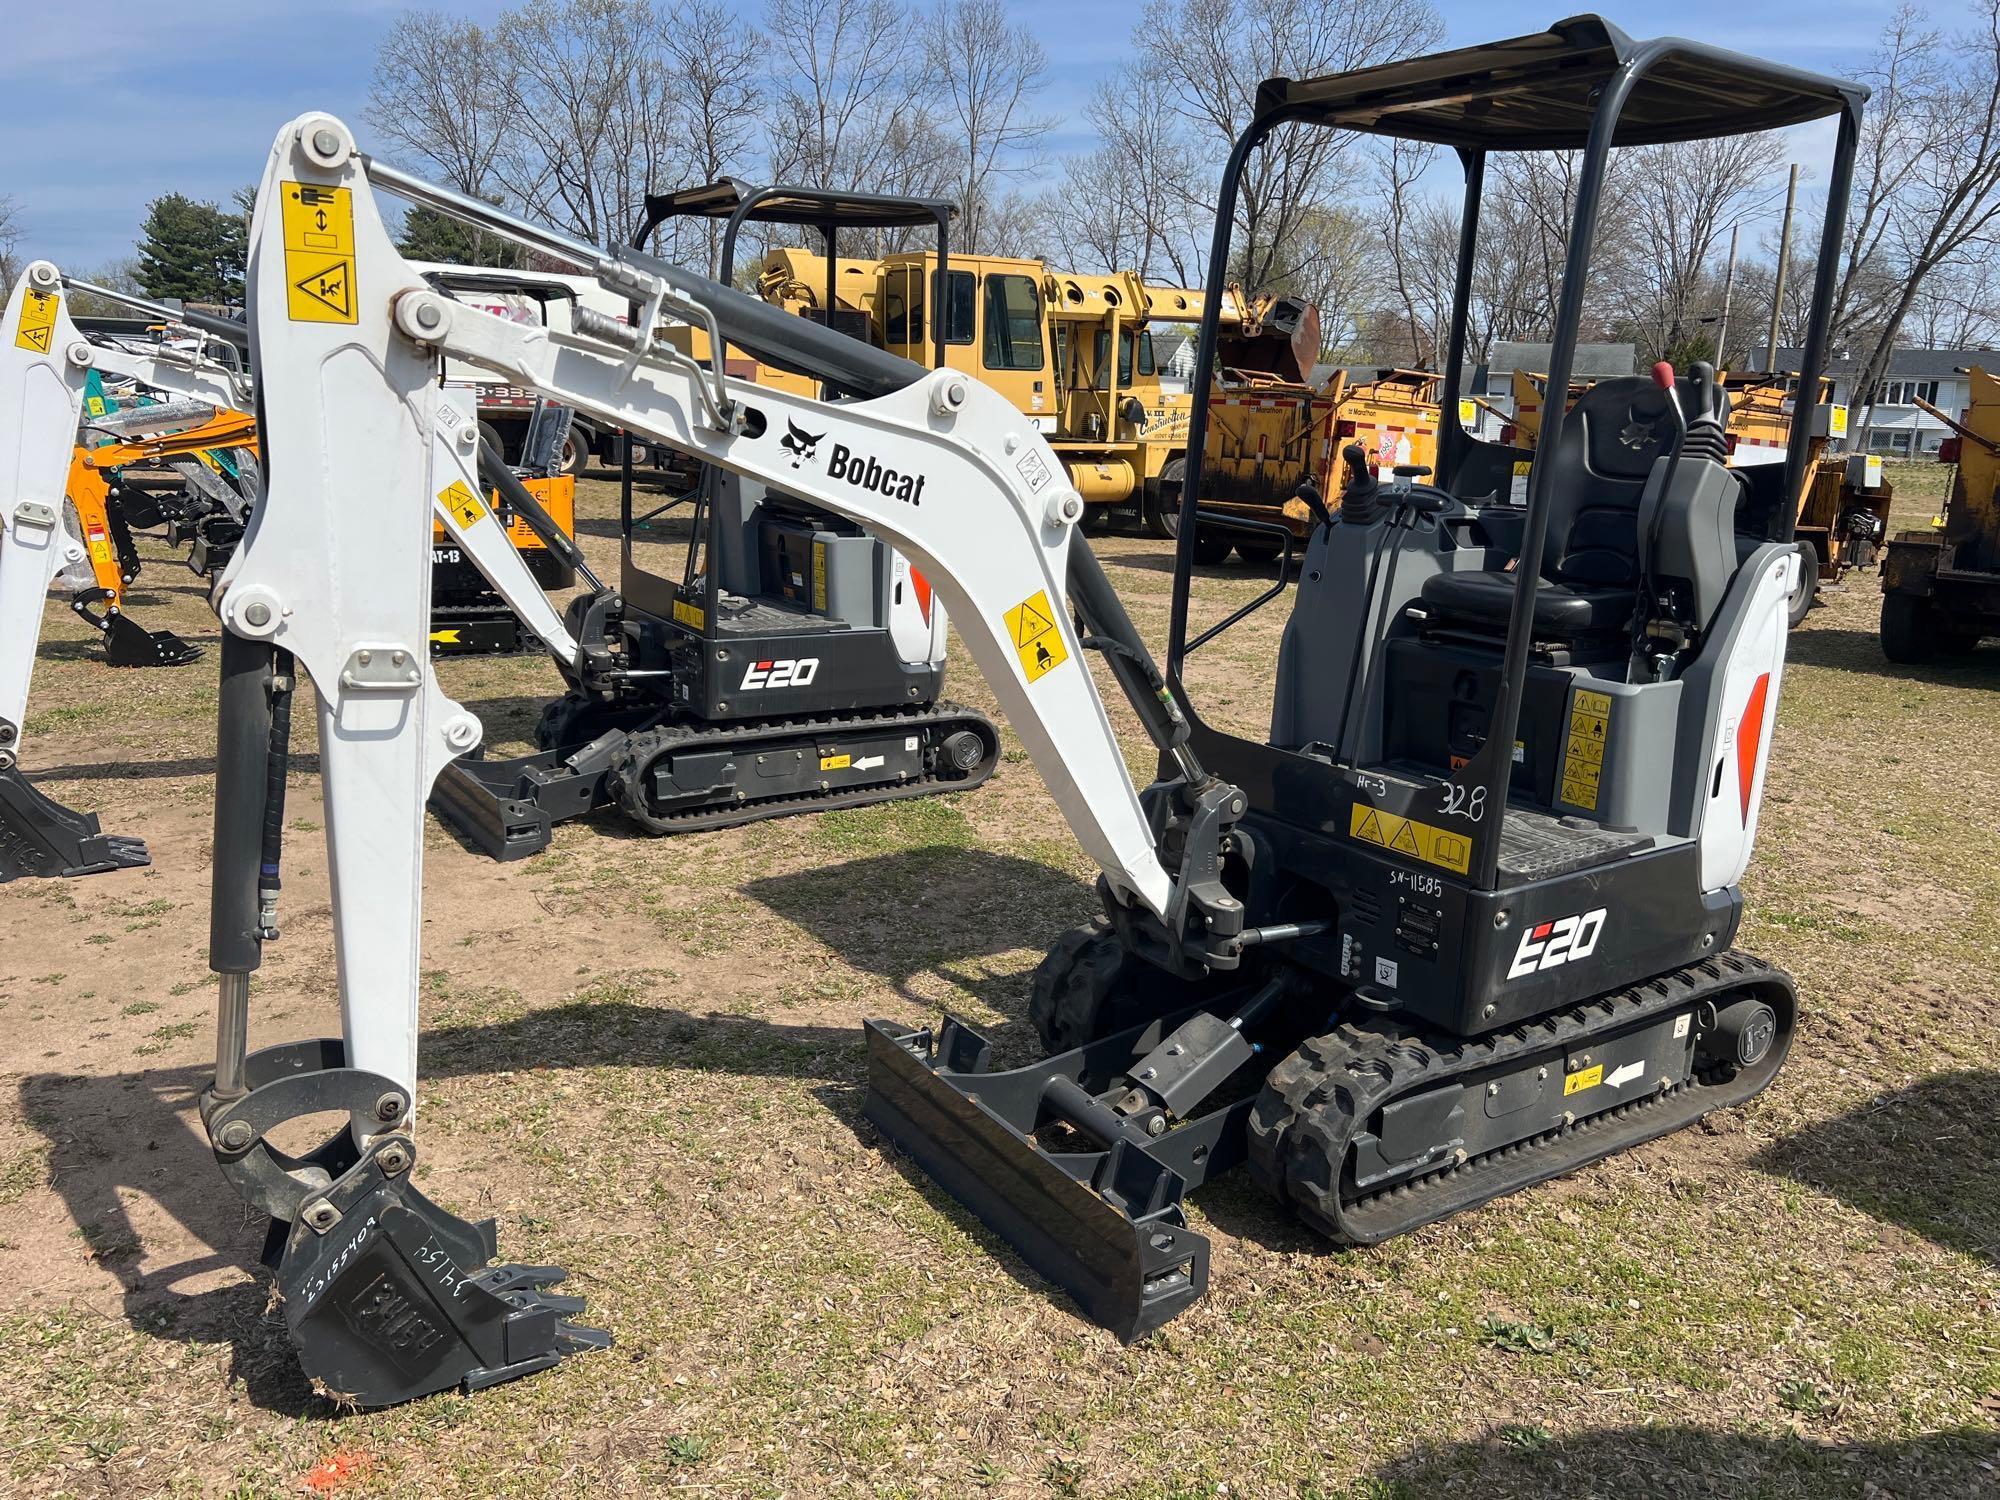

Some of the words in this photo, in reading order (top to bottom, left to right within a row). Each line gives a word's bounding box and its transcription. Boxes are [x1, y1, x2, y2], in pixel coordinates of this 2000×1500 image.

[1256, 406, 1283, 415] Marathon
[1353, 408, 1377, 417] Marathon
[827, 442, 926, 507] Bobcat
[739, 658, 820, 691] E20
[1437, 782, 1488, 822] 328
[1506, 906, 1608, 980] E20
